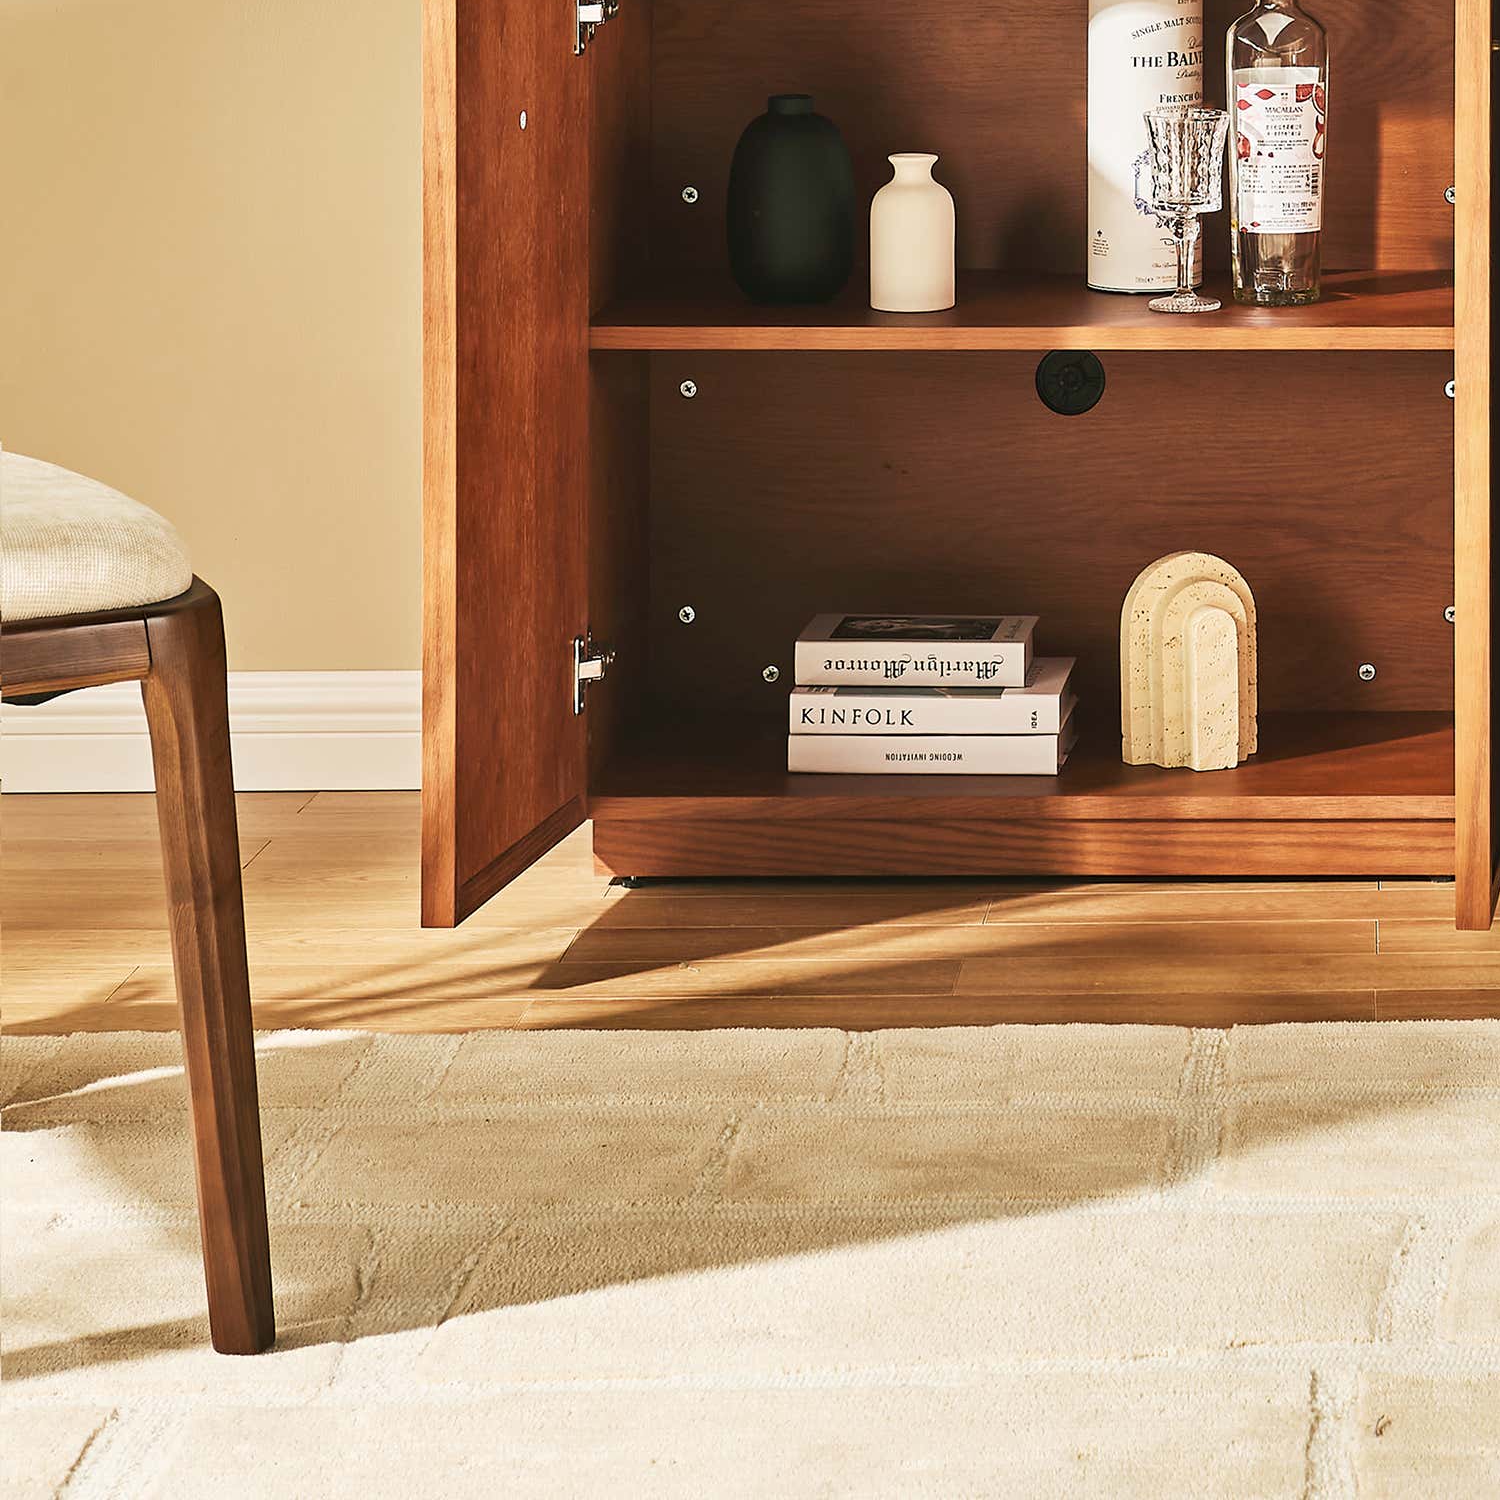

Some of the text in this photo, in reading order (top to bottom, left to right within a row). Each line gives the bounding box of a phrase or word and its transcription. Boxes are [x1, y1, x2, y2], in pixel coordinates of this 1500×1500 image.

[1131, 22, 1162, 39] SINGLE
[1163, 17, 1185, 29] MALT
[1130, 55, 1163, 68] THE
[1159, 93, 1194, 104] FRENCH
[1264, 106, 1304, 114] MACALLAN
[823, 653, 912, 679] Monroe
[912, 654, 1005, 680] Marilyn
[801, 708, 914, 726] KINFOLK
[885, 753, 963, 761] WEDDING INVITATION
